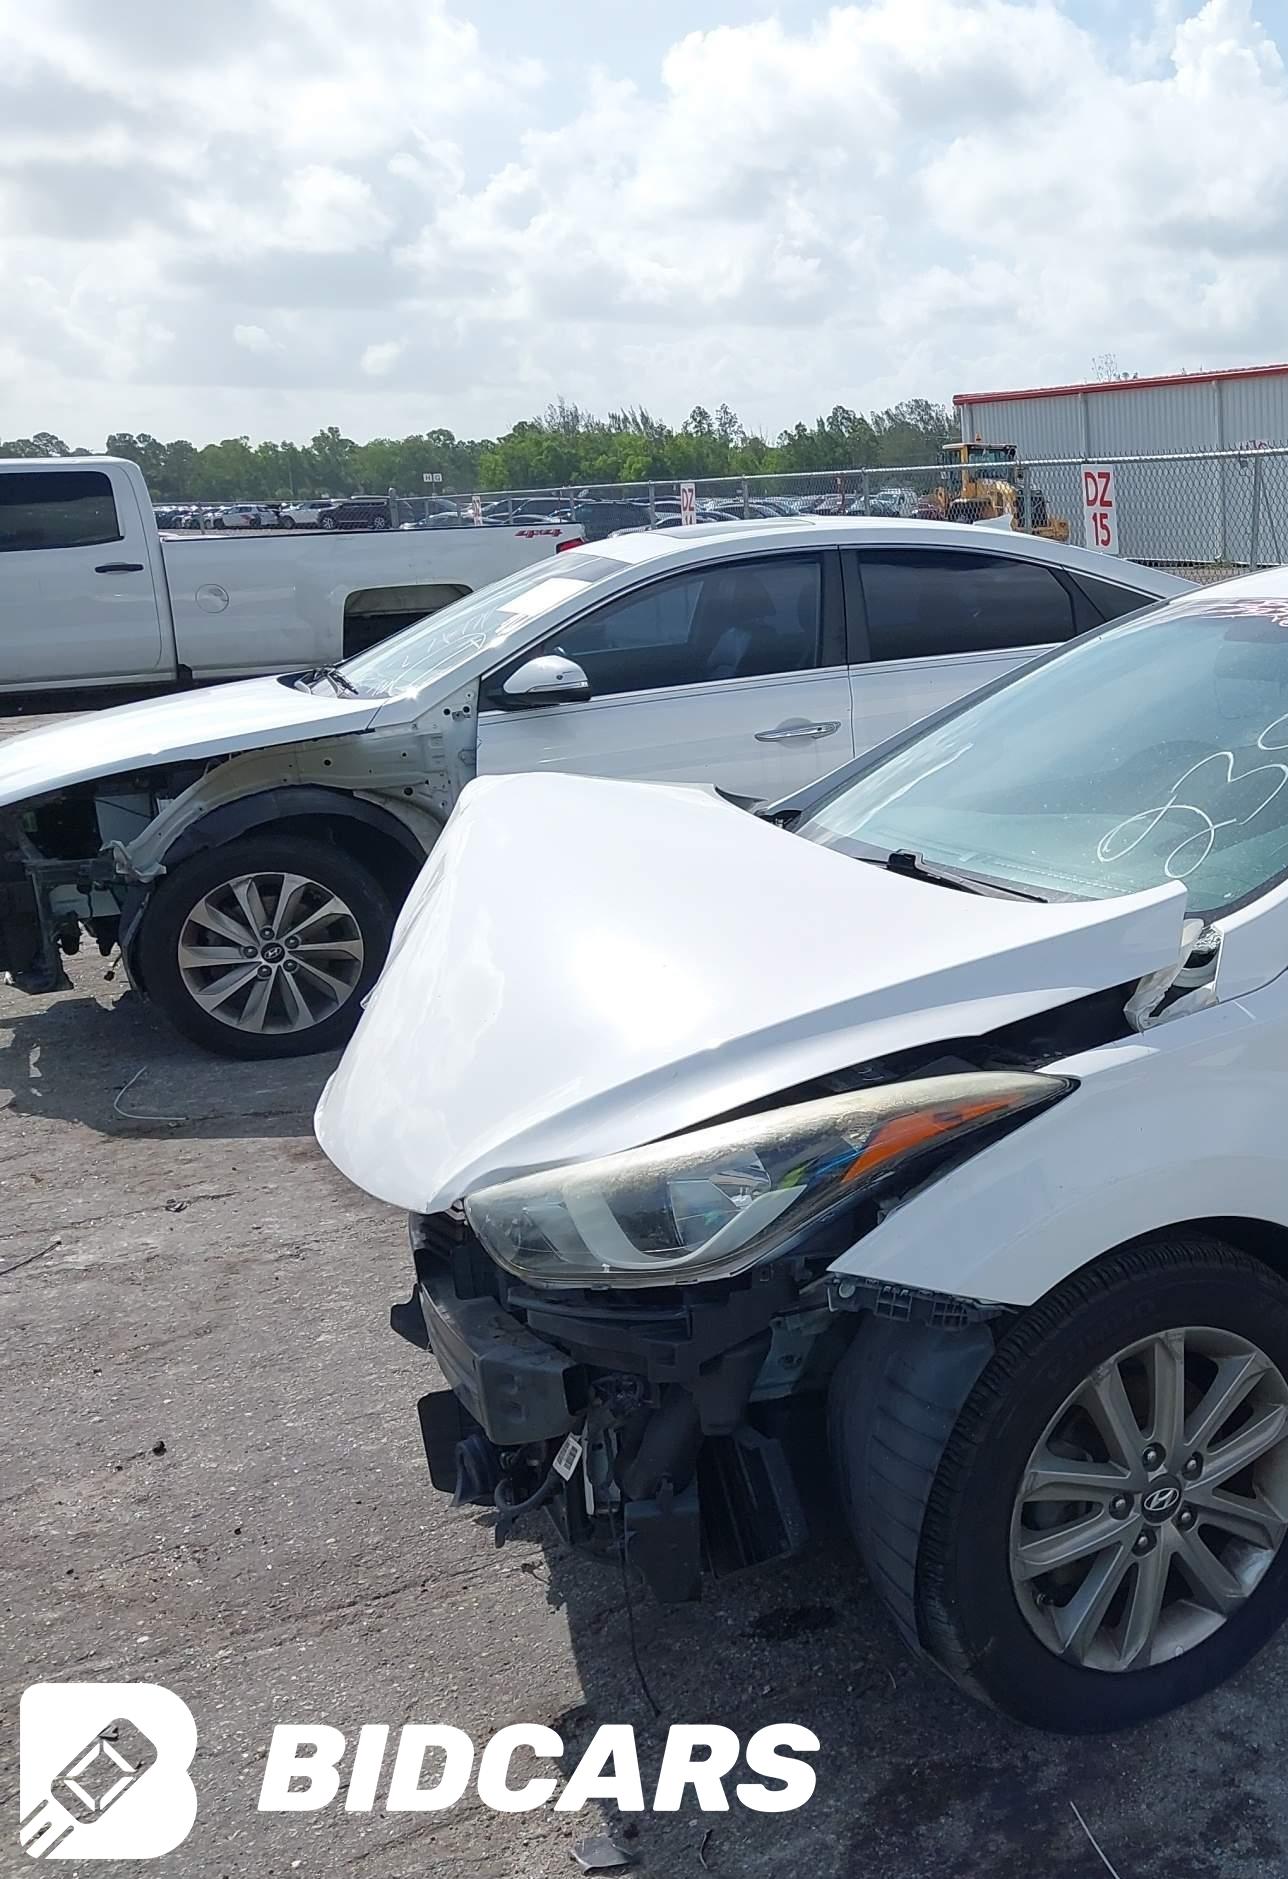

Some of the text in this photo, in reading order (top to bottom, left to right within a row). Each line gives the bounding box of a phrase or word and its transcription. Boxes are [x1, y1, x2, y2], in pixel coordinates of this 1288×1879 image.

[682, 488, 694, 511] DZ
[1084, 472, 1112, 507] DZ
[1092, 512, 1110, 546] 15
